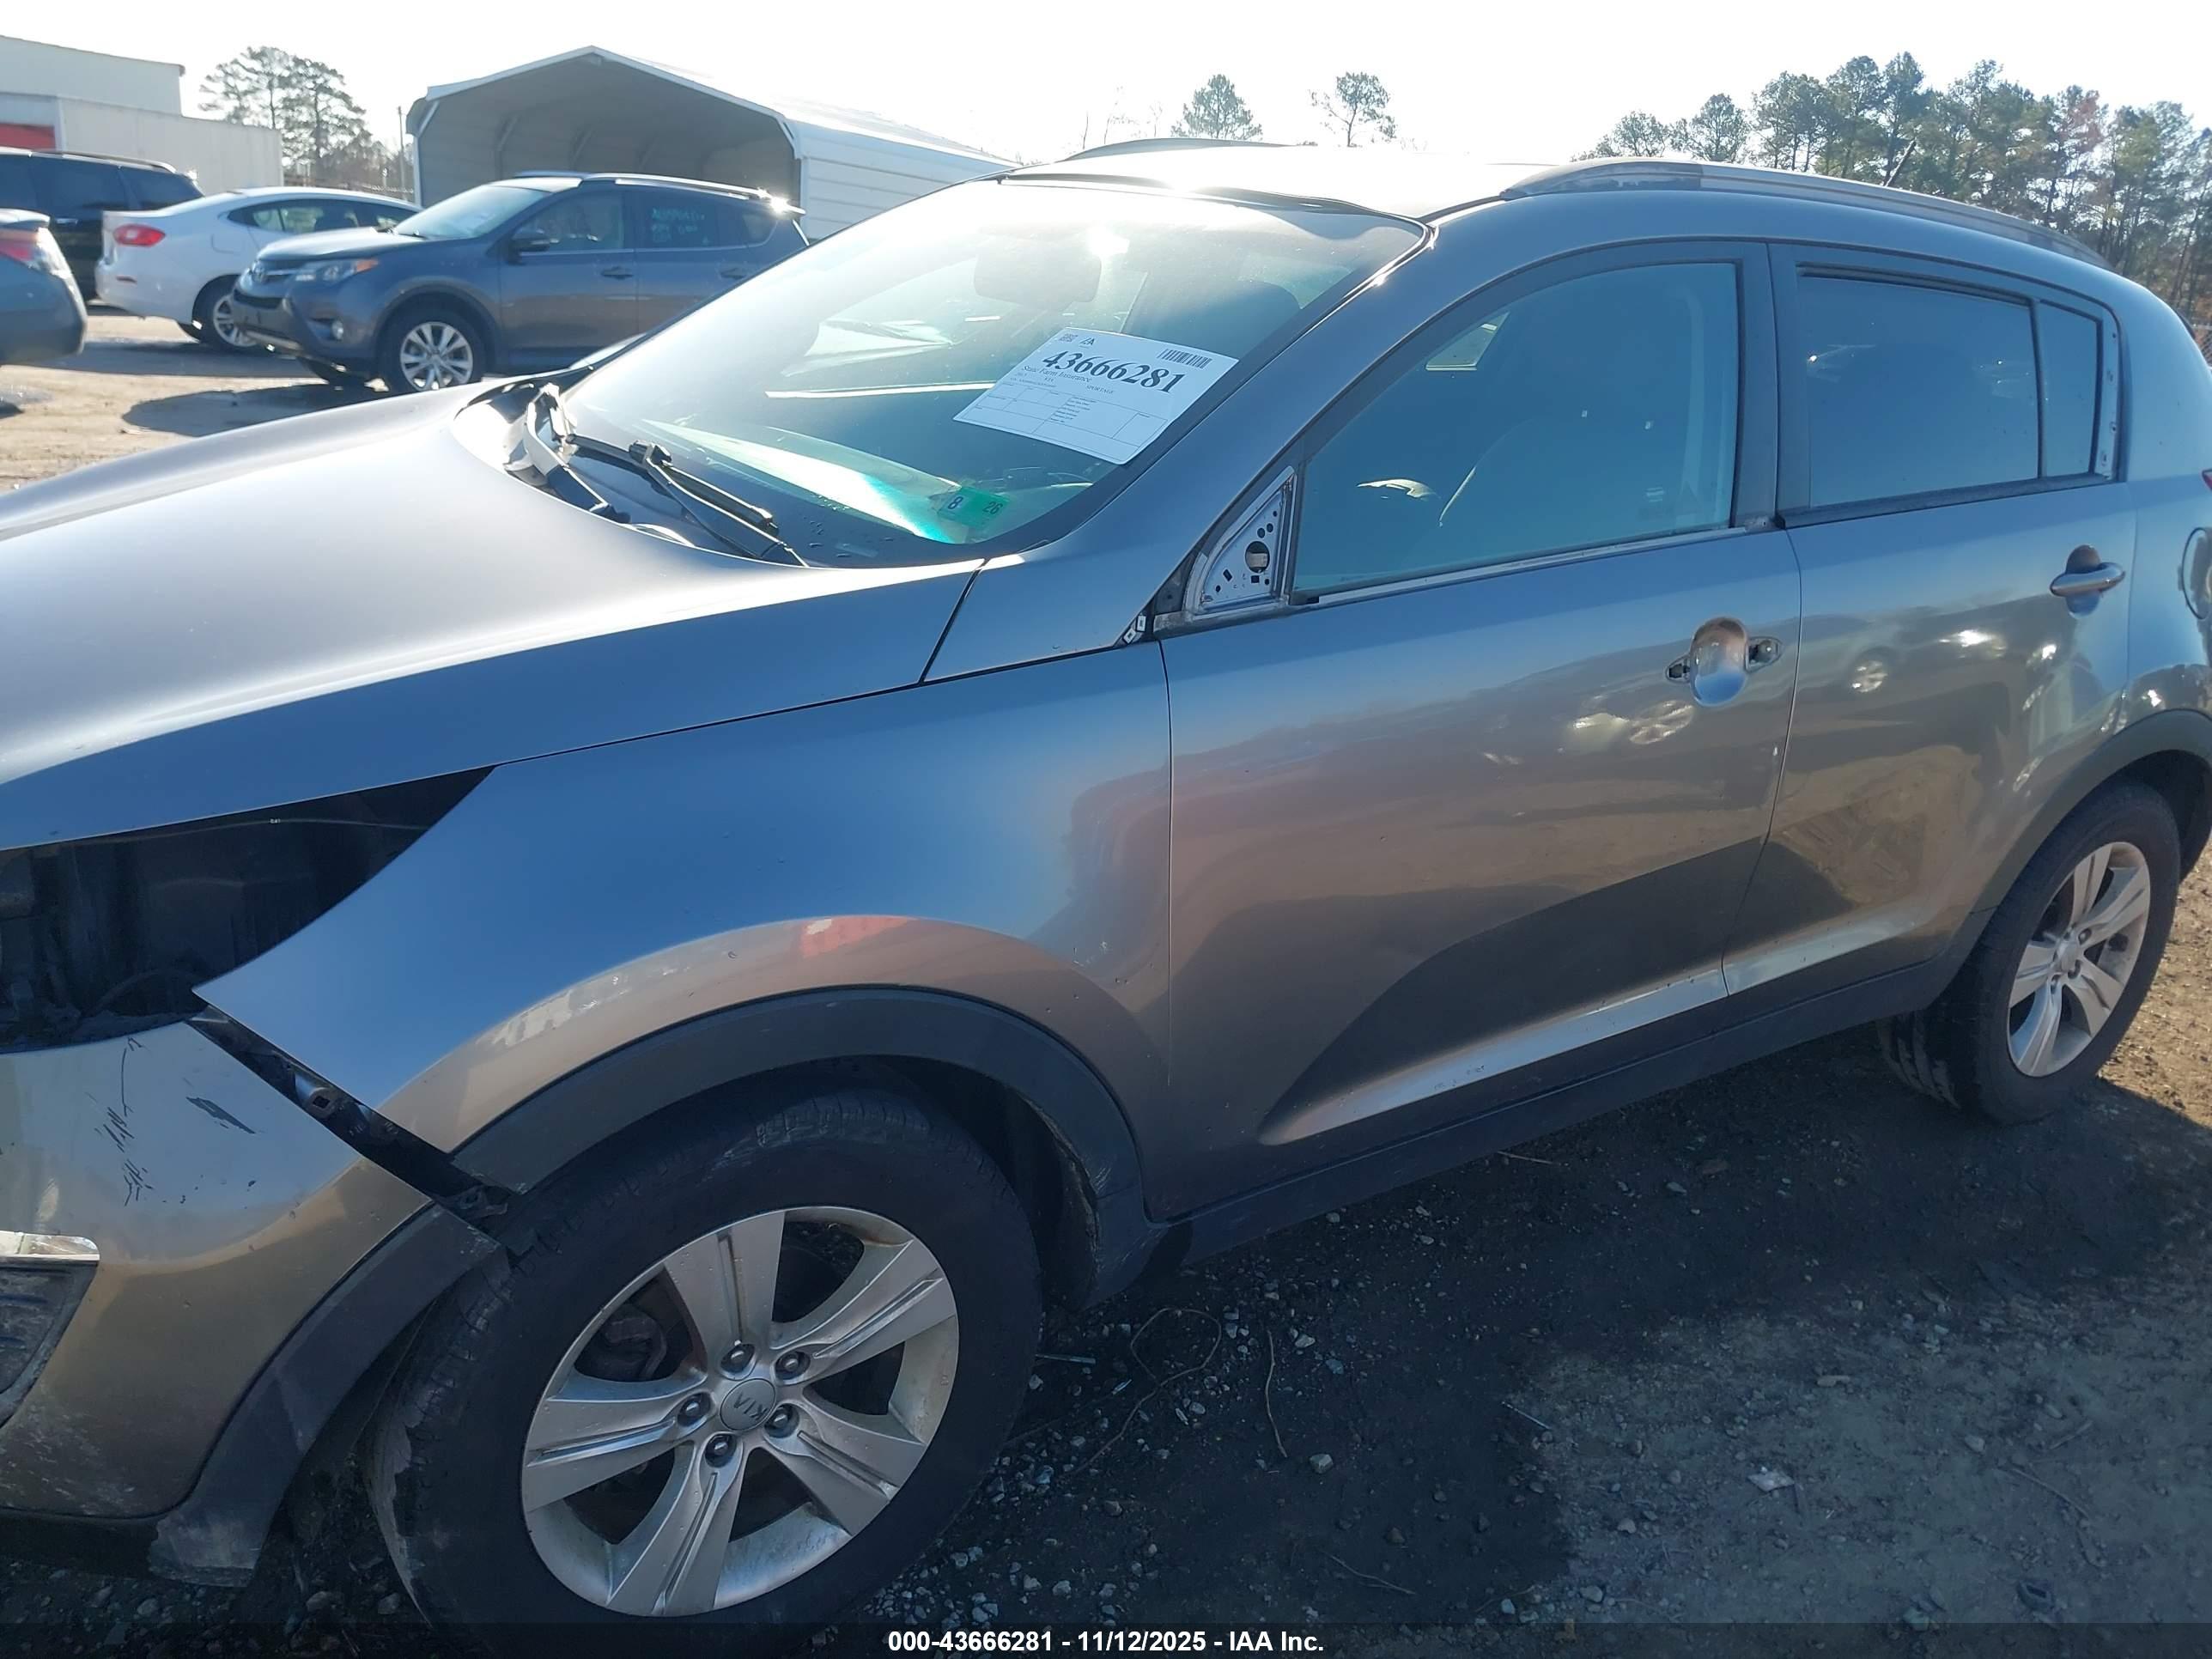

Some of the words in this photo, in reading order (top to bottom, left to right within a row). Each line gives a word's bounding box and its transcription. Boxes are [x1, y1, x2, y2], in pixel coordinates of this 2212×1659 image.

[1042, 349, 1187, 394] 43666281
[947, 495, 964, 510] 8
[732, 1392, 769, 1421] KIA
